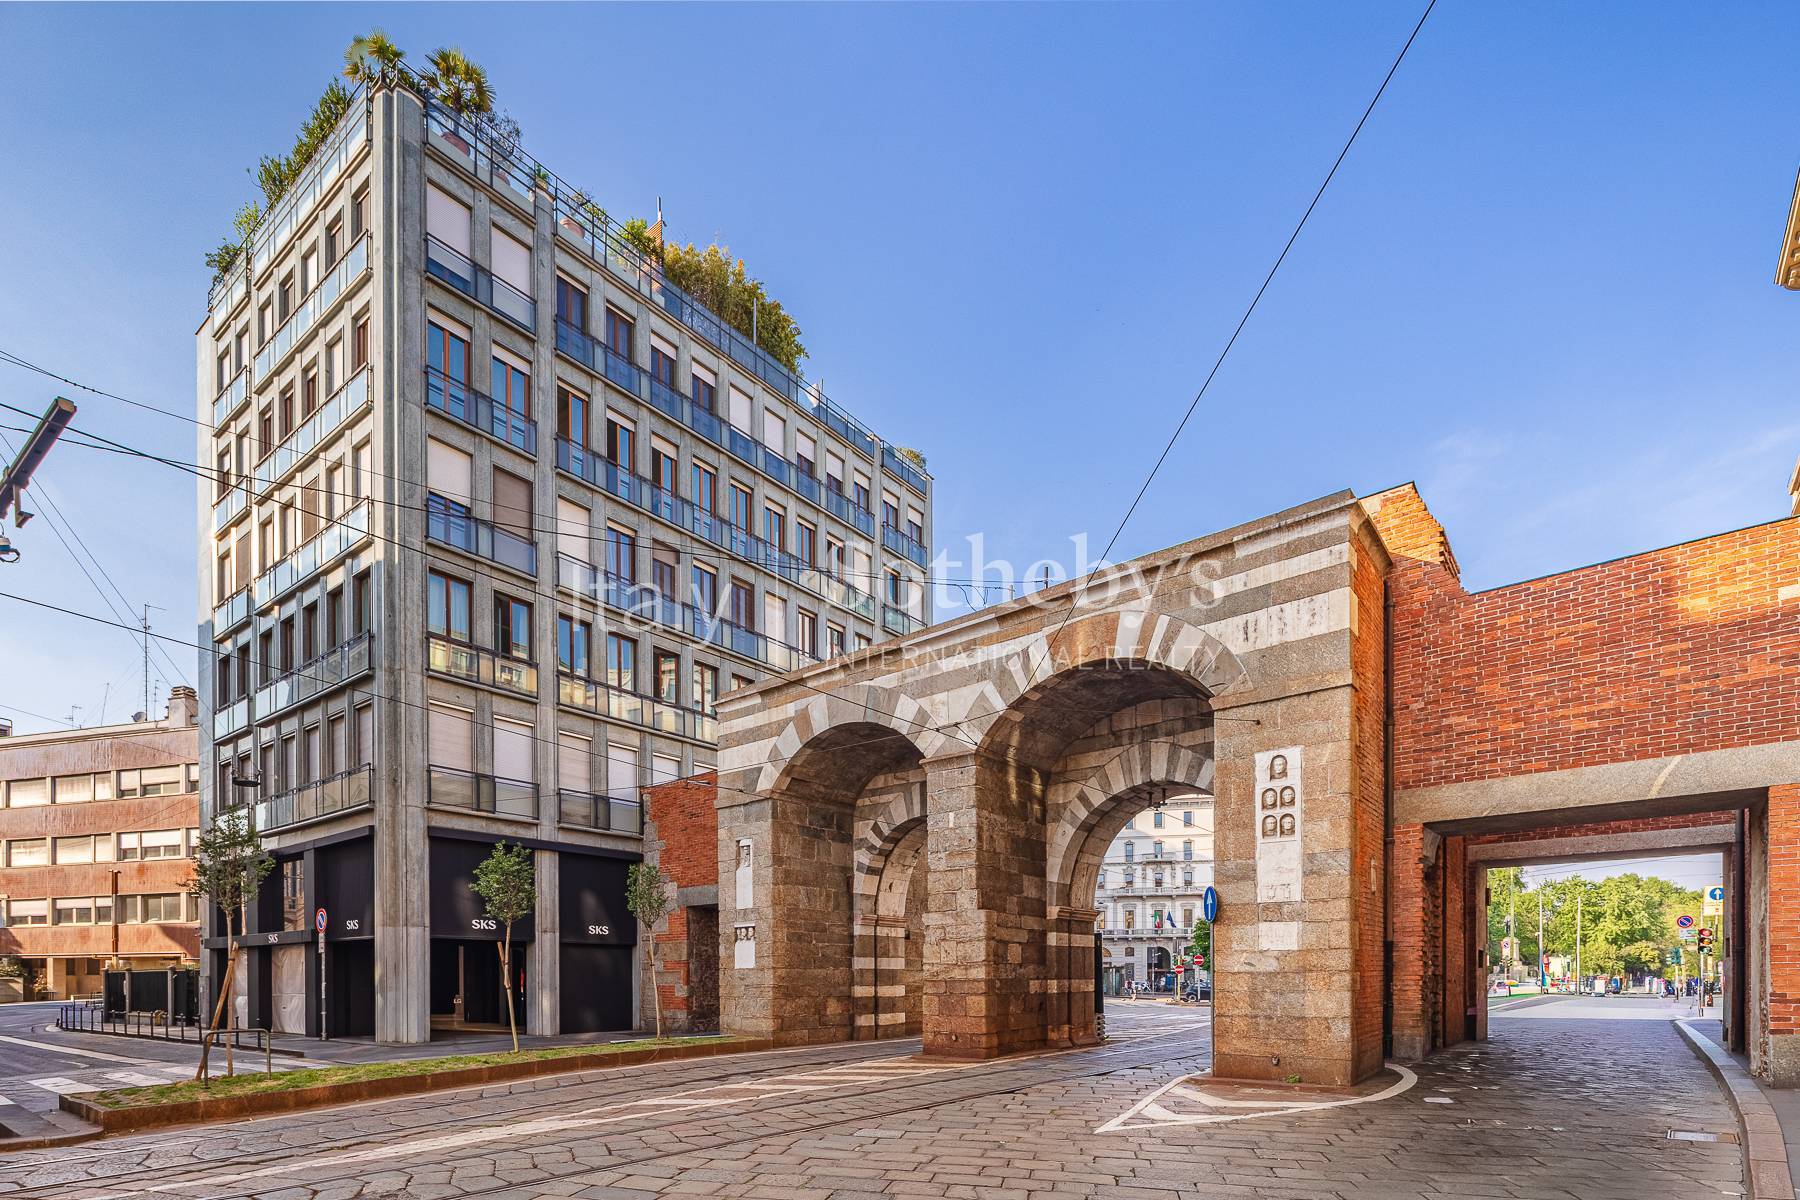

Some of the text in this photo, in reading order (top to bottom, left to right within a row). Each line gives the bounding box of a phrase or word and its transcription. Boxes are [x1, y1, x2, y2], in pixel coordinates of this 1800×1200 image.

[347, 919, 359, 930] SKS
[471, 919, 497, 930] SKS
[588, 925, 609, 935] SKS
